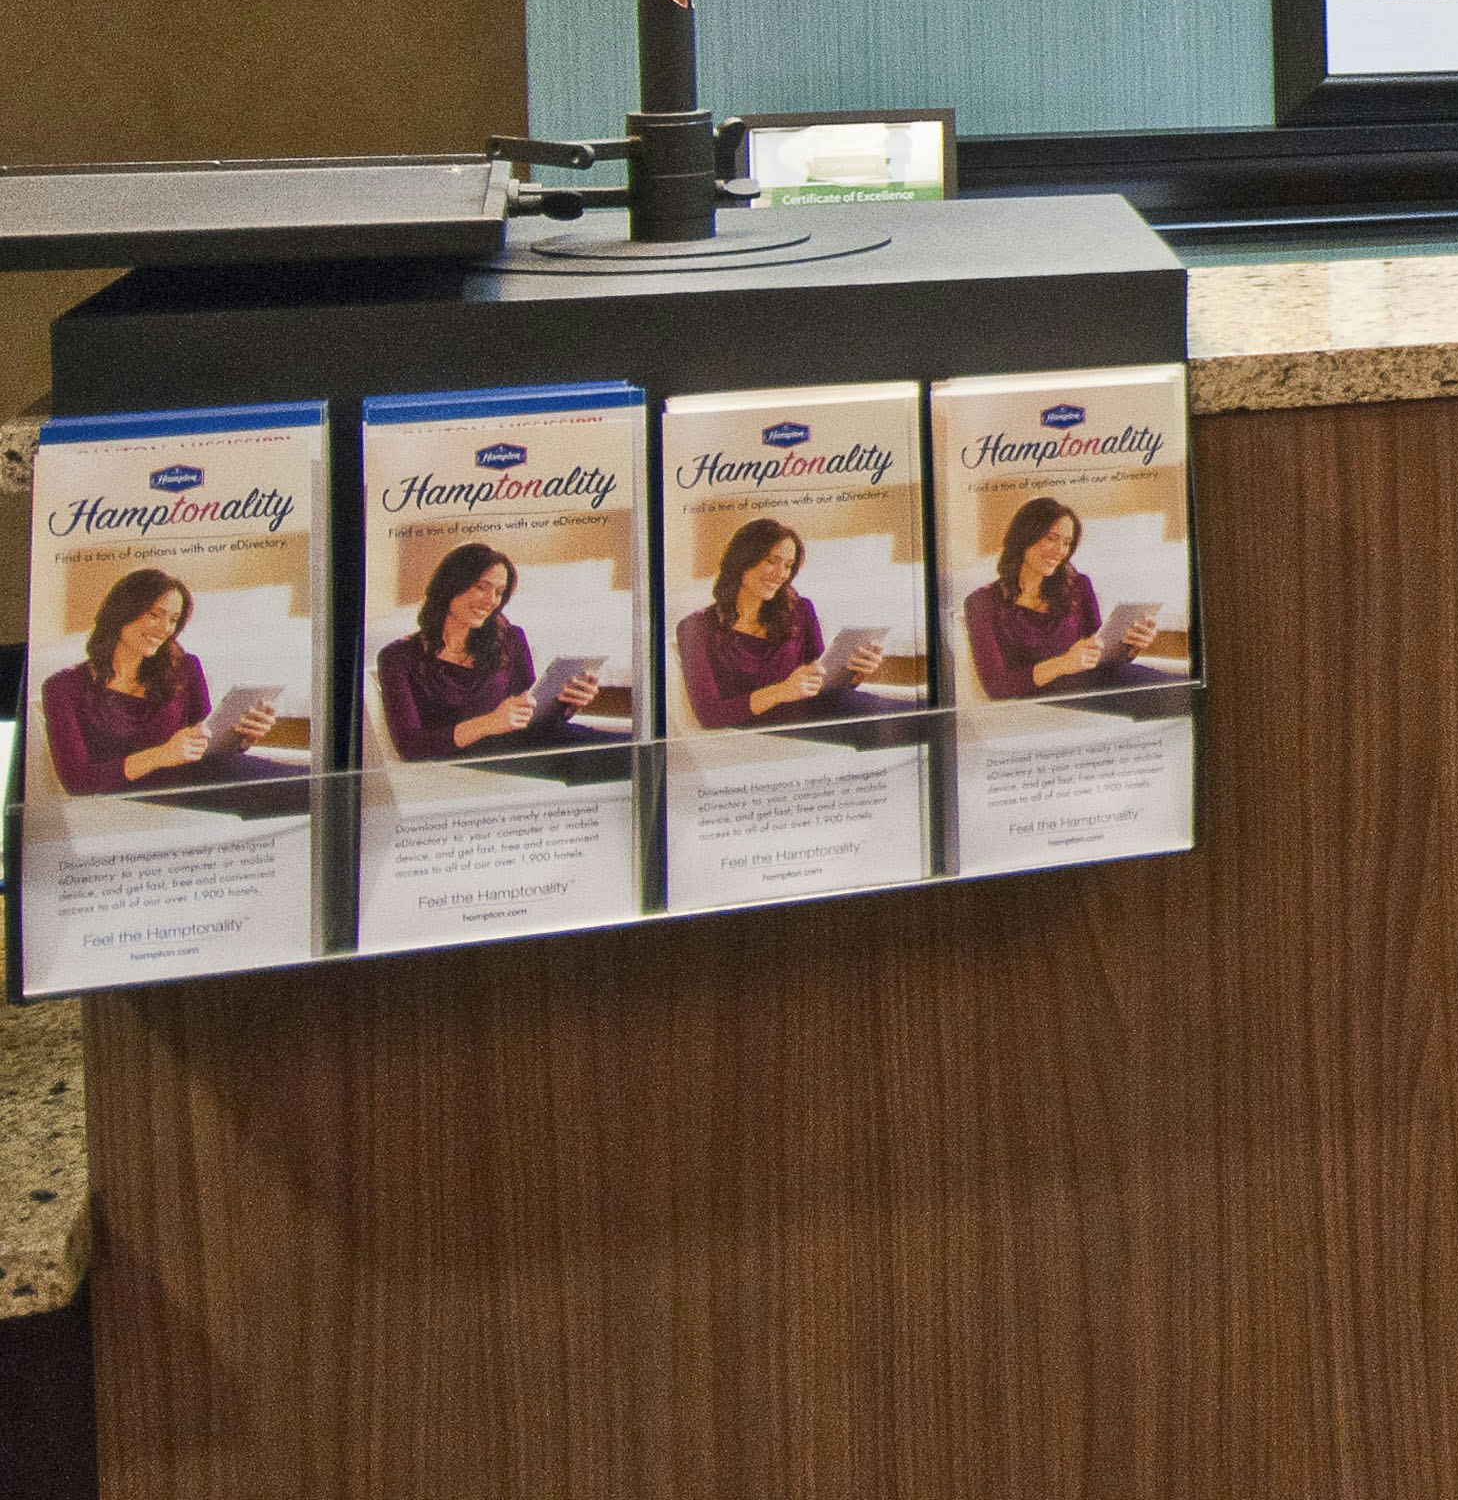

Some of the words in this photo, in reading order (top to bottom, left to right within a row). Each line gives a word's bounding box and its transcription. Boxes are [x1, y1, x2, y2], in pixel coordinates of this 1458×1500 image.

[782, 192, 841, 206] Certificate
[843, 191, 854, 204] of
[857, 190, 914, 203] Excellence
[962, 425, 1163, 469] Hamptonality
[478, 452, 521, 465] Hampton
[677, 444, 892, 489] Hamptonality
[383, 466, 616, 512] Hamptonality
[1019, 478, 1030, 489] of
[1031, 478, 1066, 491] options
[49, 487, 294, 536] Hamptonality
[738, 499, 750, 510] of
[751, 499, 789, 513] options
[793, 494, 813, 504] with
[426, 526, 445, 535] ton
[462, 523, 501, 535] options
[505, 519, 528, 530] with
[531, 520, 549, 528] our
[96, 550, 117, 560] ton
[120, 549, 132, 558] of
[135, 546, 176, 559] options
[180, 543, 205, 554] with
[208, 545, 226, 553] our
[1009, 822, 1034, 835] Feel
[1037, 819, 1057, 832] the
[721, 856, 749, 869] Feel
[752, 853, 773, 866] the
[419, 896, 448, 909] Feel
[451, 893, 473, 904] the
[84, 933, 114, 947] Feel
[119, 931, 142, 943] the
